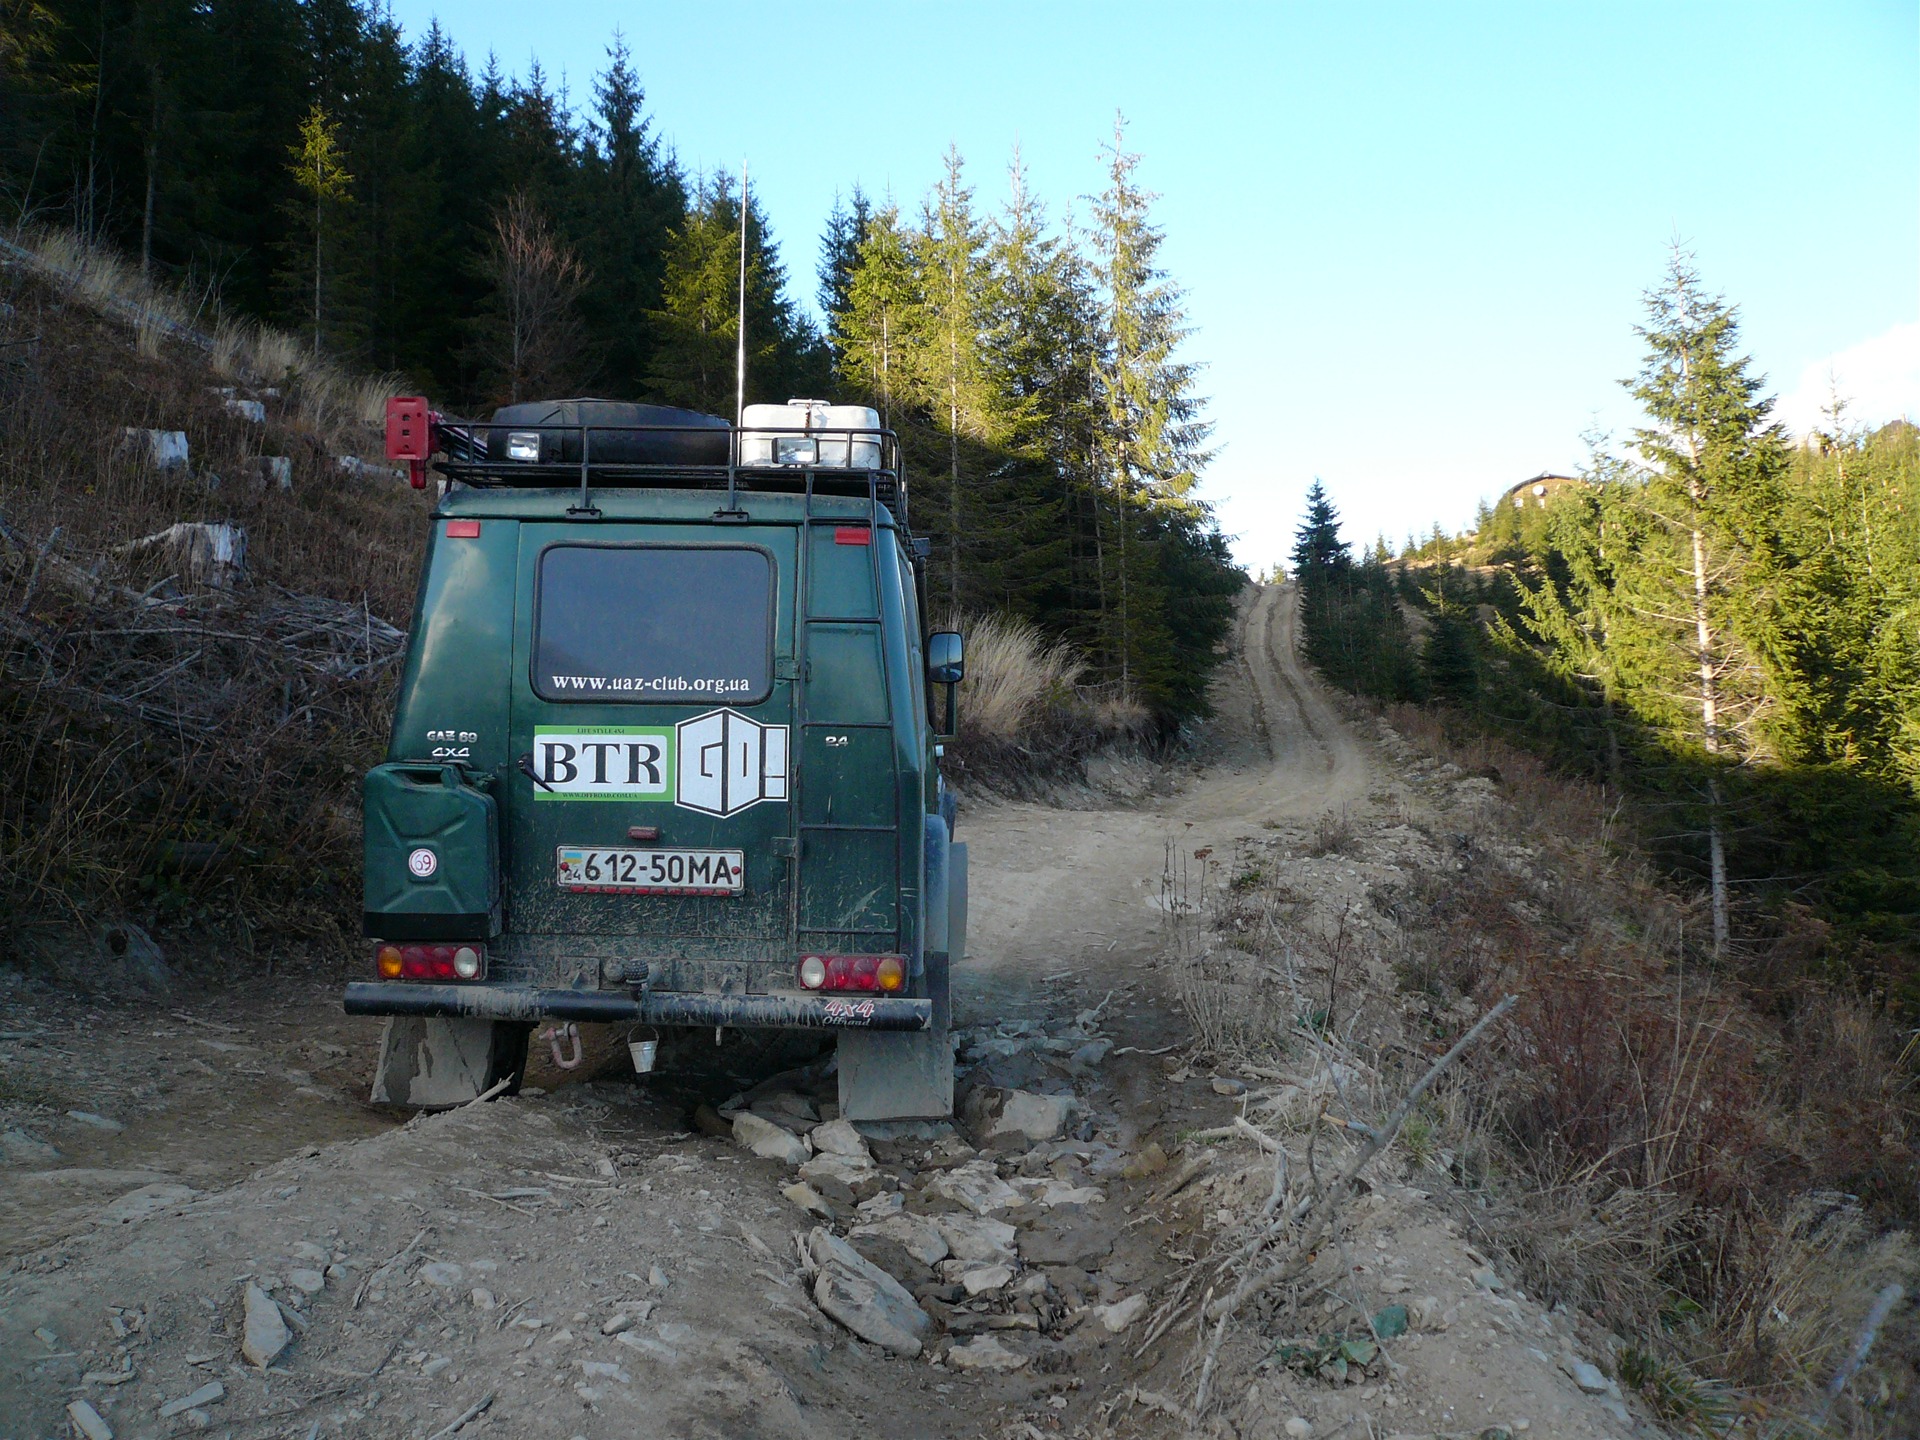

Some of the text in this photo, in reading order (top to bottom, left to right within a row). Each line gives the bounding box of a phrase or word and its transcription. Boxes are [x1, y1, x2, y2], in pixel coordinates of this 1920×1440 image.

[552, 675, 750, 693] www.uaz-club.org.ua
[427, 730, 477, 743] GAZ 69
[540, 742, 661, 784] BTR
[415, 854, 432, 871] 69
